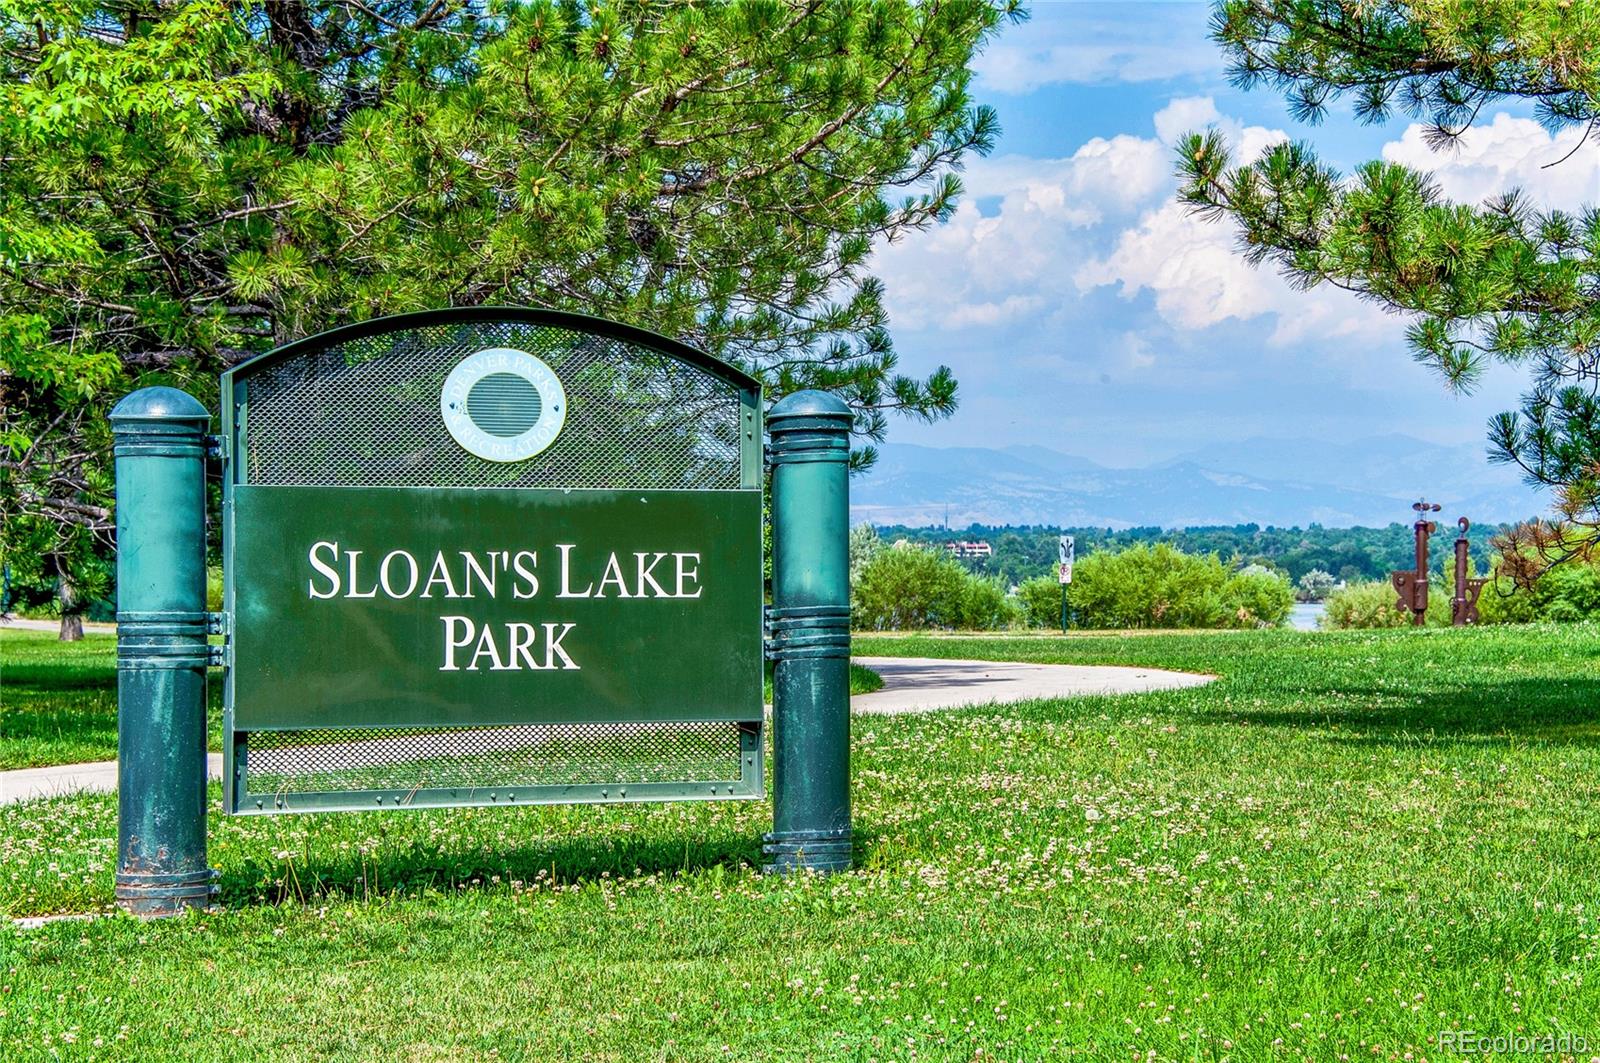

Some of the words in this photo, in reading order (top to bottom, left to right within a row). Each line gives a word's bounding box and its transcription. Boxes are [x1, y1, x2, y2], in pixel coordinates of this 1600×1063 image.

[450, 354, 508, 398] DENVER
[515, 356, 558, 401] PARKS
[460, 416, 557, 456] RECREATION
[308, 541, 539, 600] SLOAN'S
[556, 543, 702, 599] LAKE
[438, 615, 581, 671] PARK
